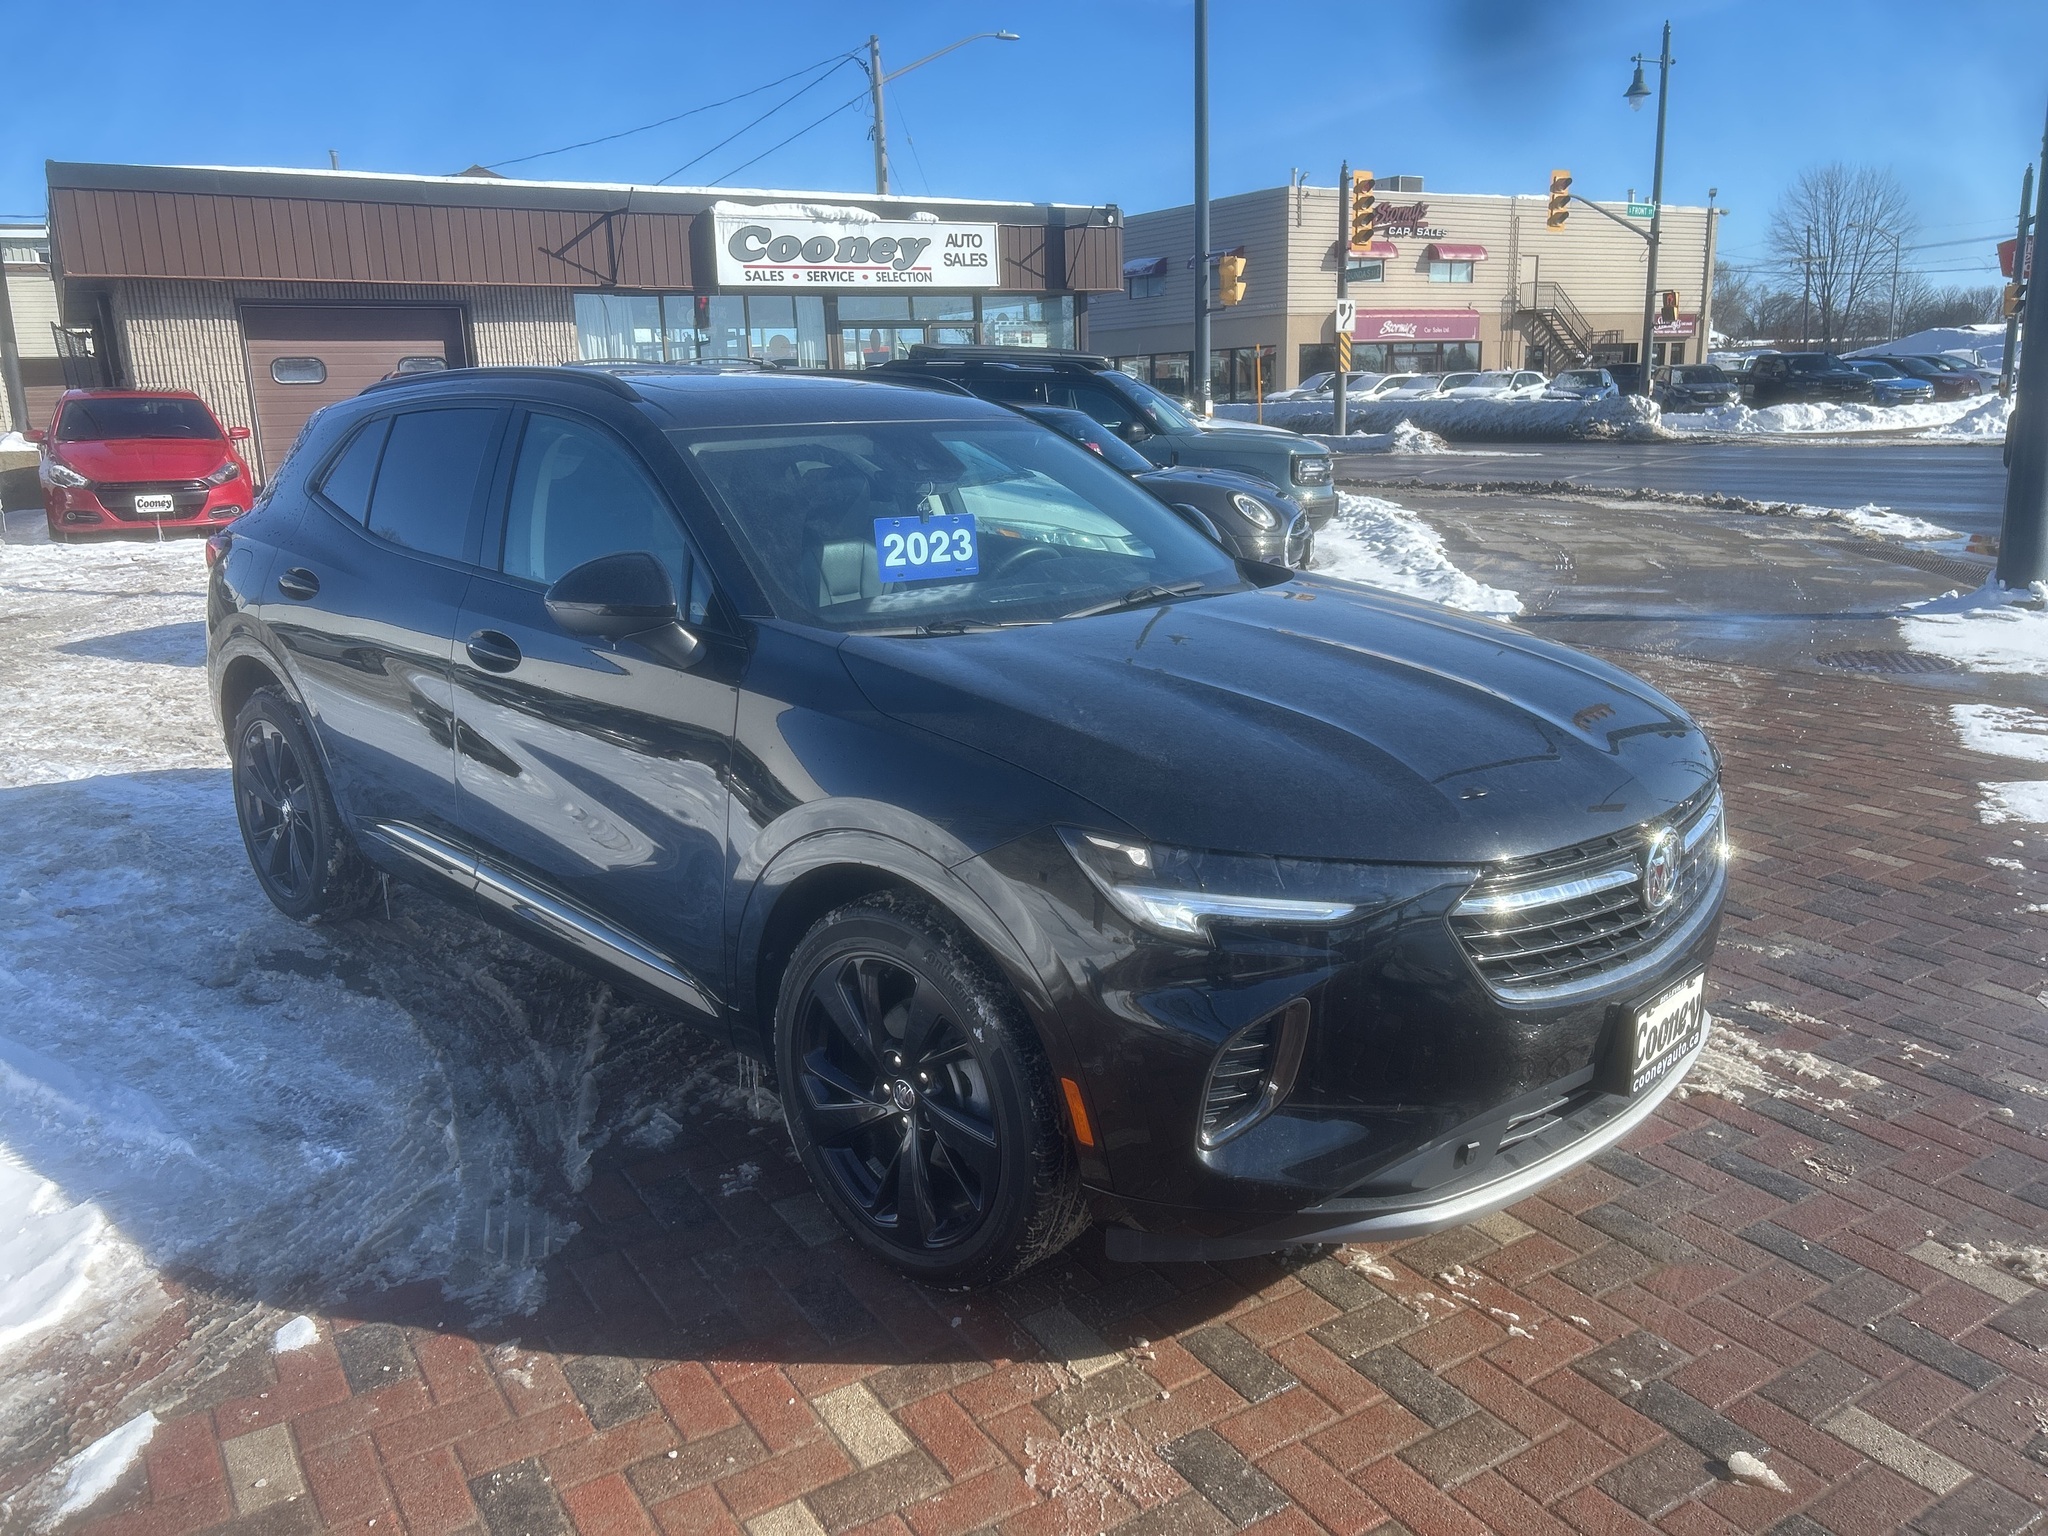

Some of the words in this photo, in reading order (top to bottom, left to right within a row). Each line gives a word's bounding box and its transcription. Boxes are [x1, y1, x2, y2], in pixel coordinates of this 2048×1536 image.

[1632, 206, 1648, 216] FRONT
[1388, 226, 1411, 235] CAR
[1416, 227, 1449, 237] SALES
[728, 225, 931, 270] Cooney
[945, 233, 983, 248] AUTO
[943, 252, 988, 267] SALES
[745, 270, 785, 282] SALES
[807, 271, 855, 282] SERVICE
[876, 271, 933, 283] SELECTION
[137, 499, 171, 509] Cooney
[883, 528, 973, 567] 2023
[1634, 993, 1702, 1067] Cooney
[1632, 1031, 1700, 1093] cooneyauto.ca
